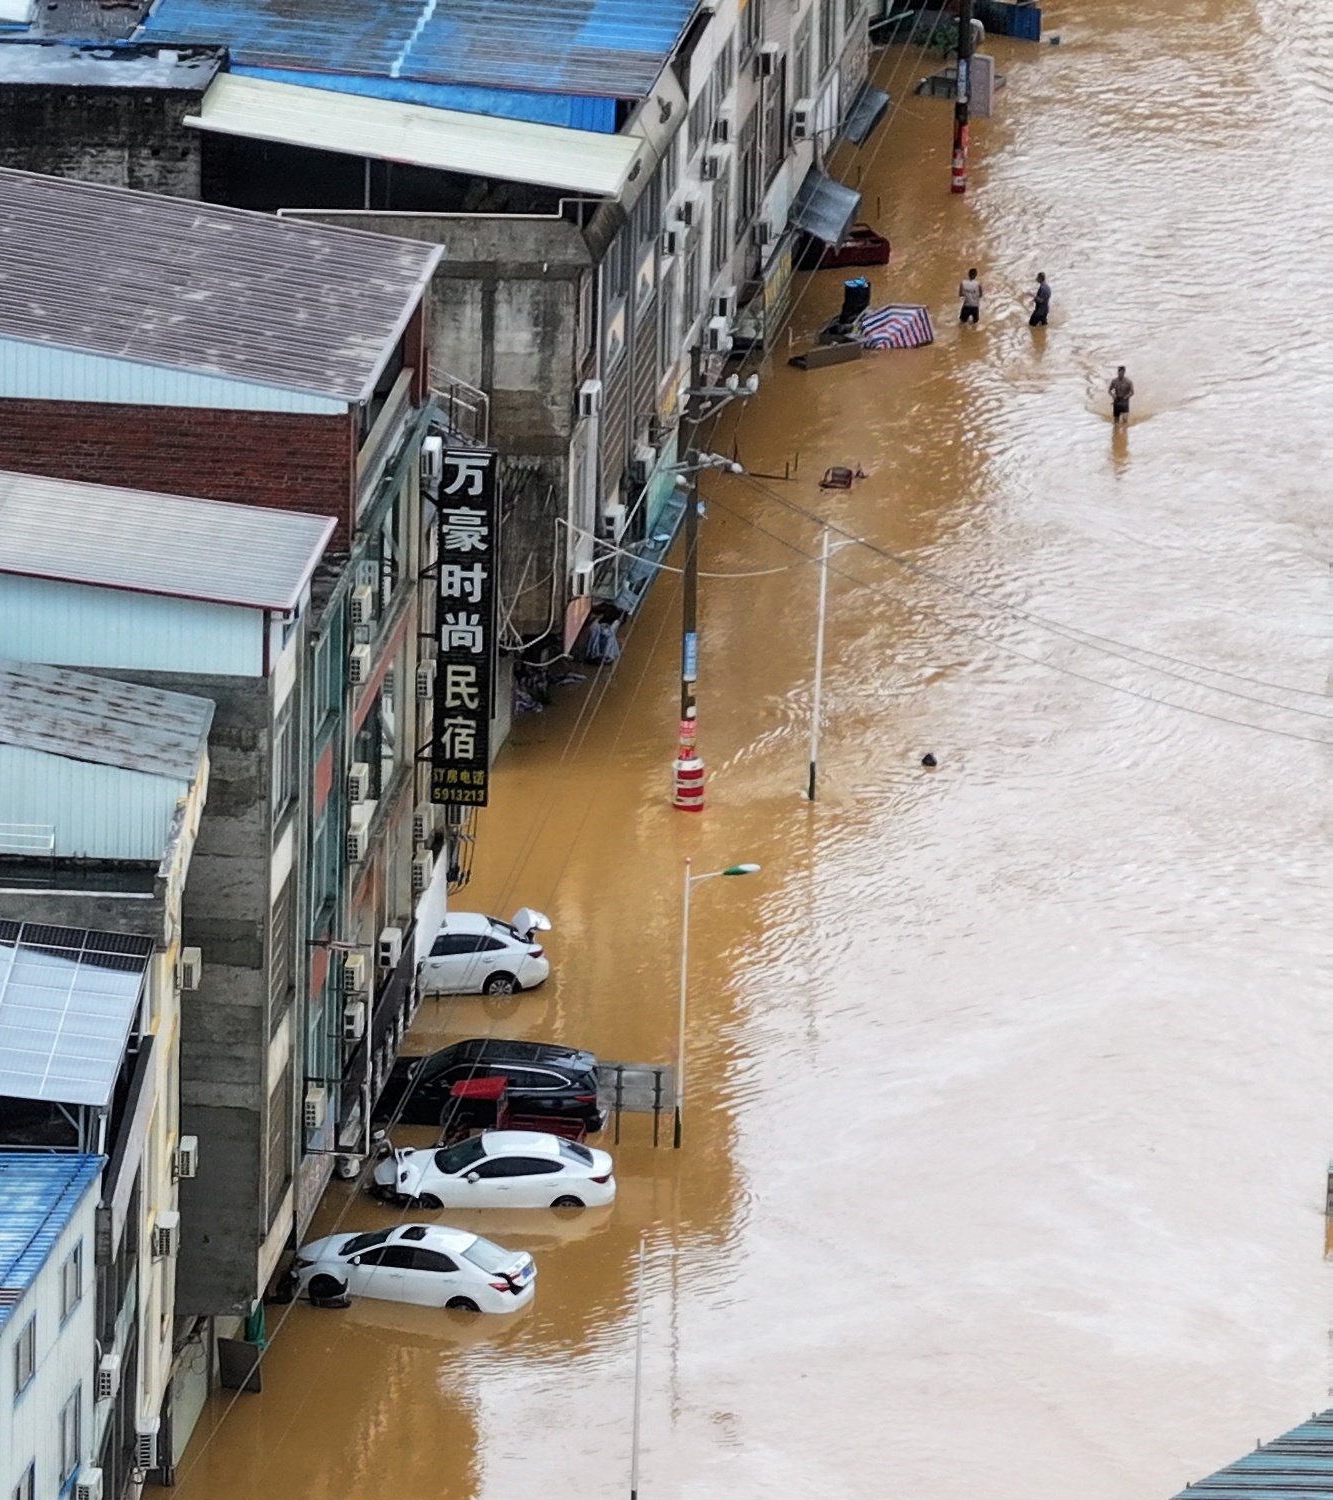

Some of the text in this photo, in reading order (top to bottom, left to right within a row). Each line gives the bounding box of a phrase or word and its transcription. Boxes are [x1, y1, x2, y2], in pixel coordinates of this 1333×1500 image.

[441, 456, 489, 761] 万豪时尚民宿
